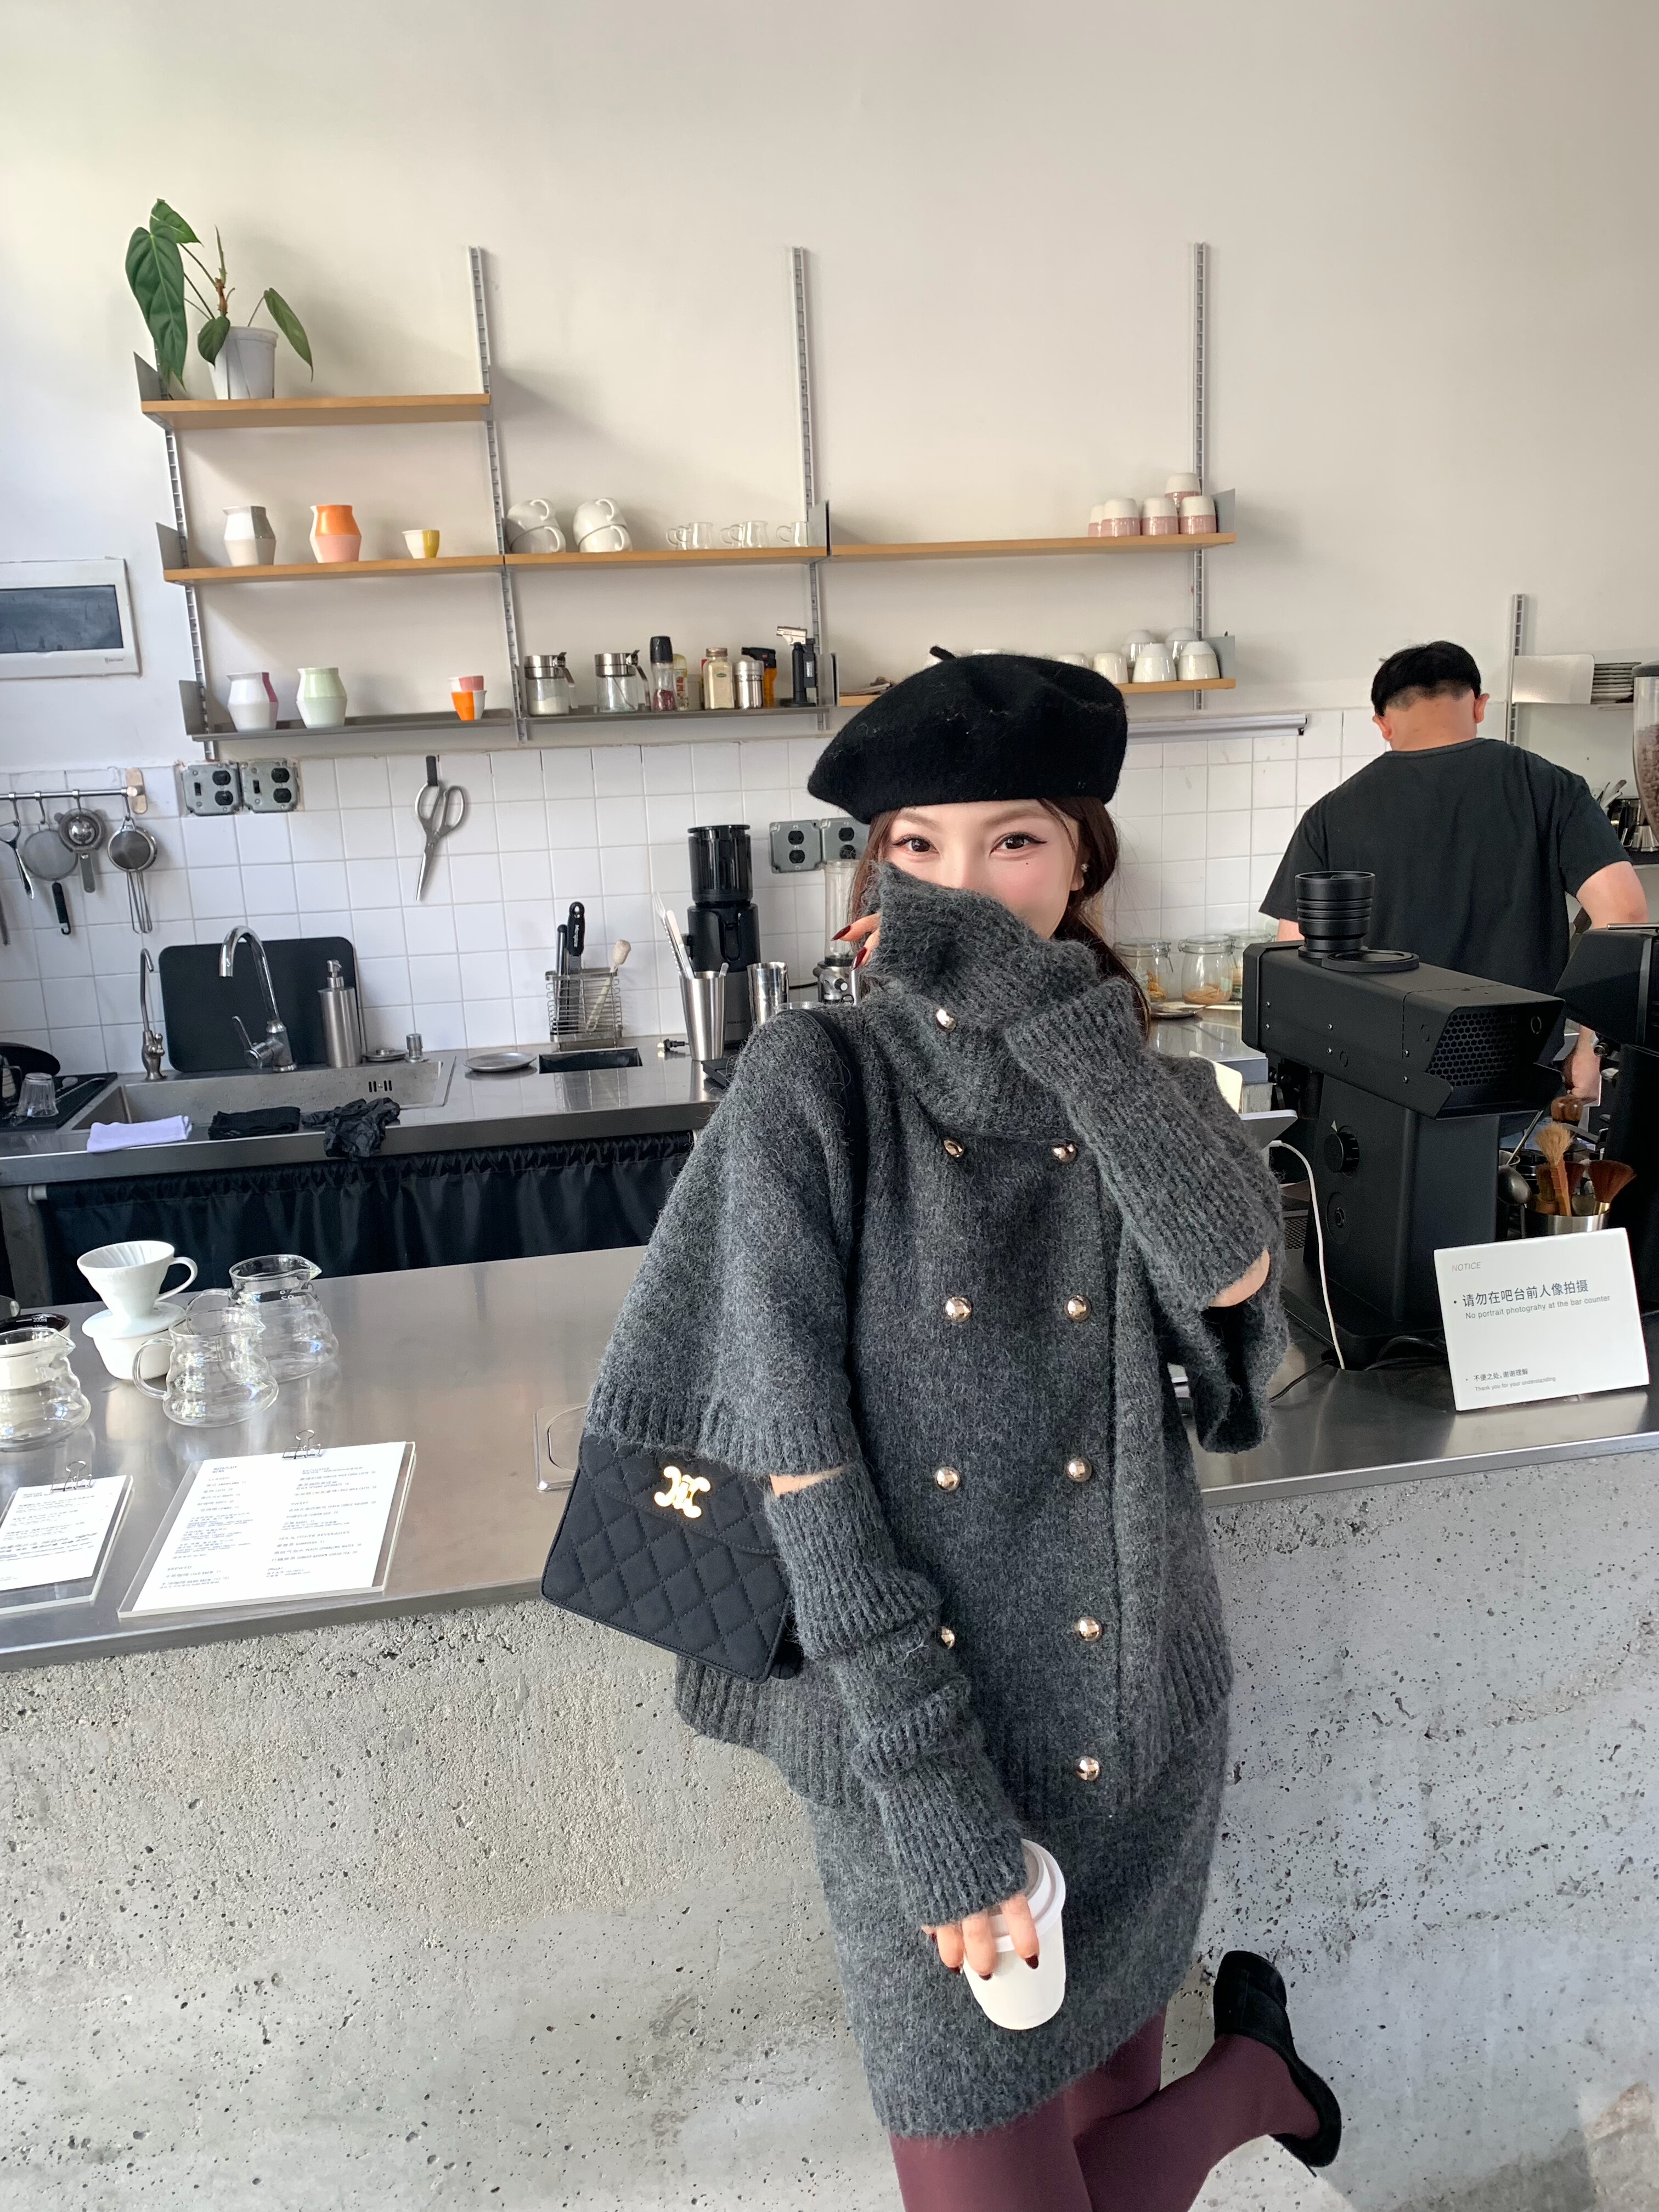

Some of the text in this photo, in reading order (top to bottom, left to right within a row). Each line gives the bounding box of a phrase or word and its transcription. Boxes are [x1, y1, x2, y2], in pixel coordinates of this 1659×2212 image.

[1452, 1261, 1481, 1272] NOTICE
[1462, 1279, 1589, 1307] 请勿在吧台前人像拍摄
[1478, 1308, 1504, 1319] portrait
[1506, 1304, 1546, 1315] photograhy
[1584, 1295, 1611, 1304] counter
[1522, 1376, 1556, 1386] understanding
